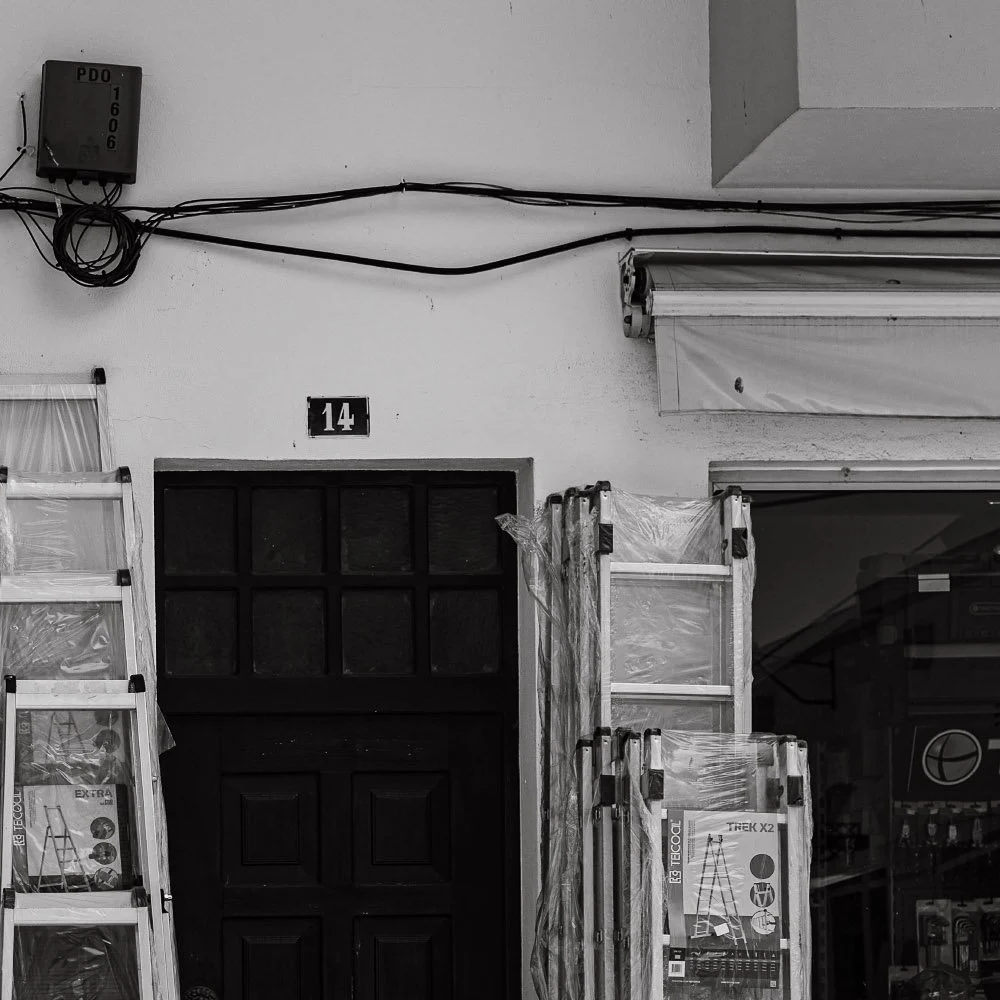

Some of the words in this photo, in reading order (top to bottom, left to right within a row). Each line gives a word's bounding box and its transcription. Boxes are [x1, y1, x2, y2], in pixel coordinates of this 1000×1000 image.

[76, 67, 111, 83] PDO
[106, 86, 120, 150] 1606
[321, 402, 355, 431] 14
[74, 789, 113, 799] EXTRA
[726, 822, 757, 832] TREK
[759, 822, 775, 833] X2
